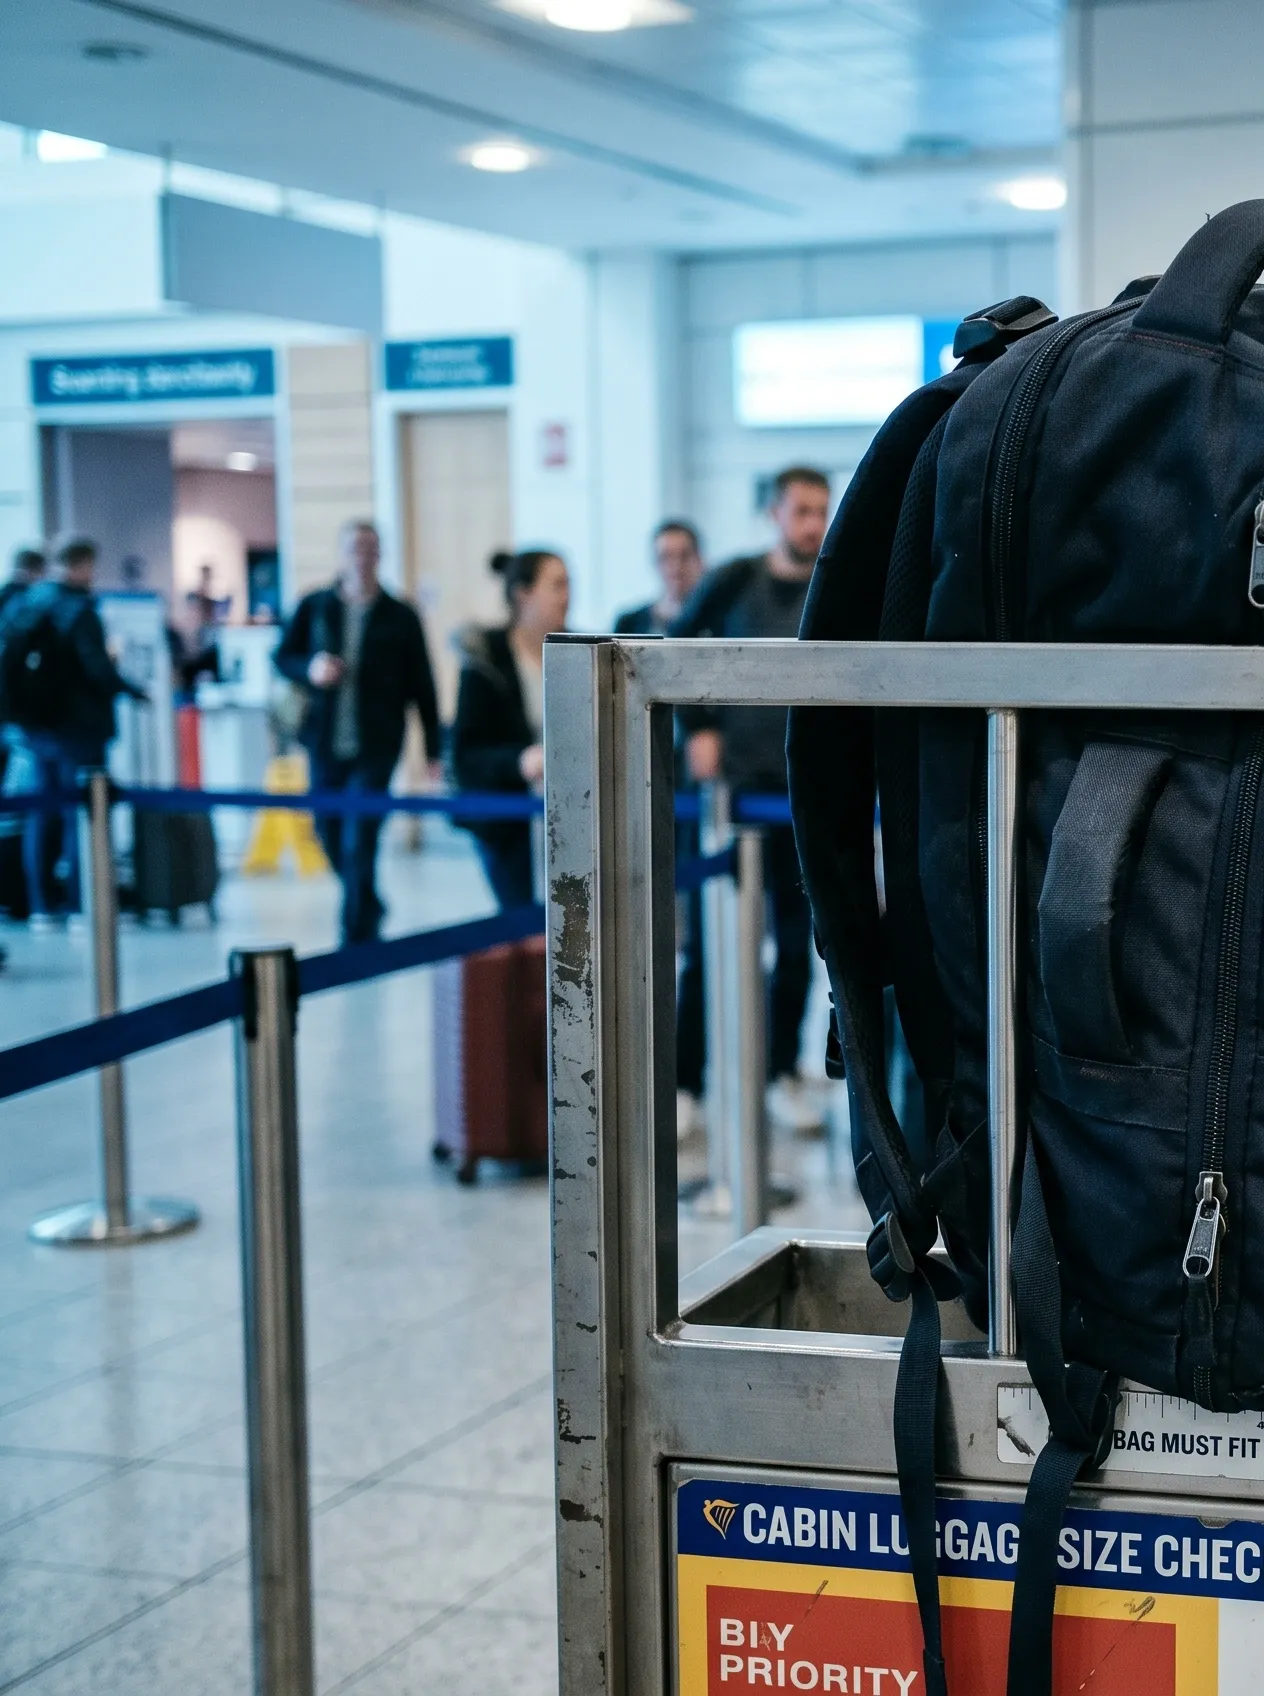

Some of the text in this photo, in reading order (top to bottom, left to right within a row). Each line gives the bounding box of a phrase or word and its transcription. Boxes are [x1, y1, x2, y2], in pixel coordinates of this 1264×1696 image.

[1257, 1420, 1264, 1430] 4
[1113, 1429, 1155, 1453] BAG
[1161, 1432, 1223, 1457] MUST
[1228, 1436, 1261, 1459] FIT
[743, 1503, 856, 1551] CABIN
[869, 1513, 1020, 1565] LUGAG
[1057, 1527, 1142, 1574] SIZE
[720, 1654, 918, 1696] PRIORITY
